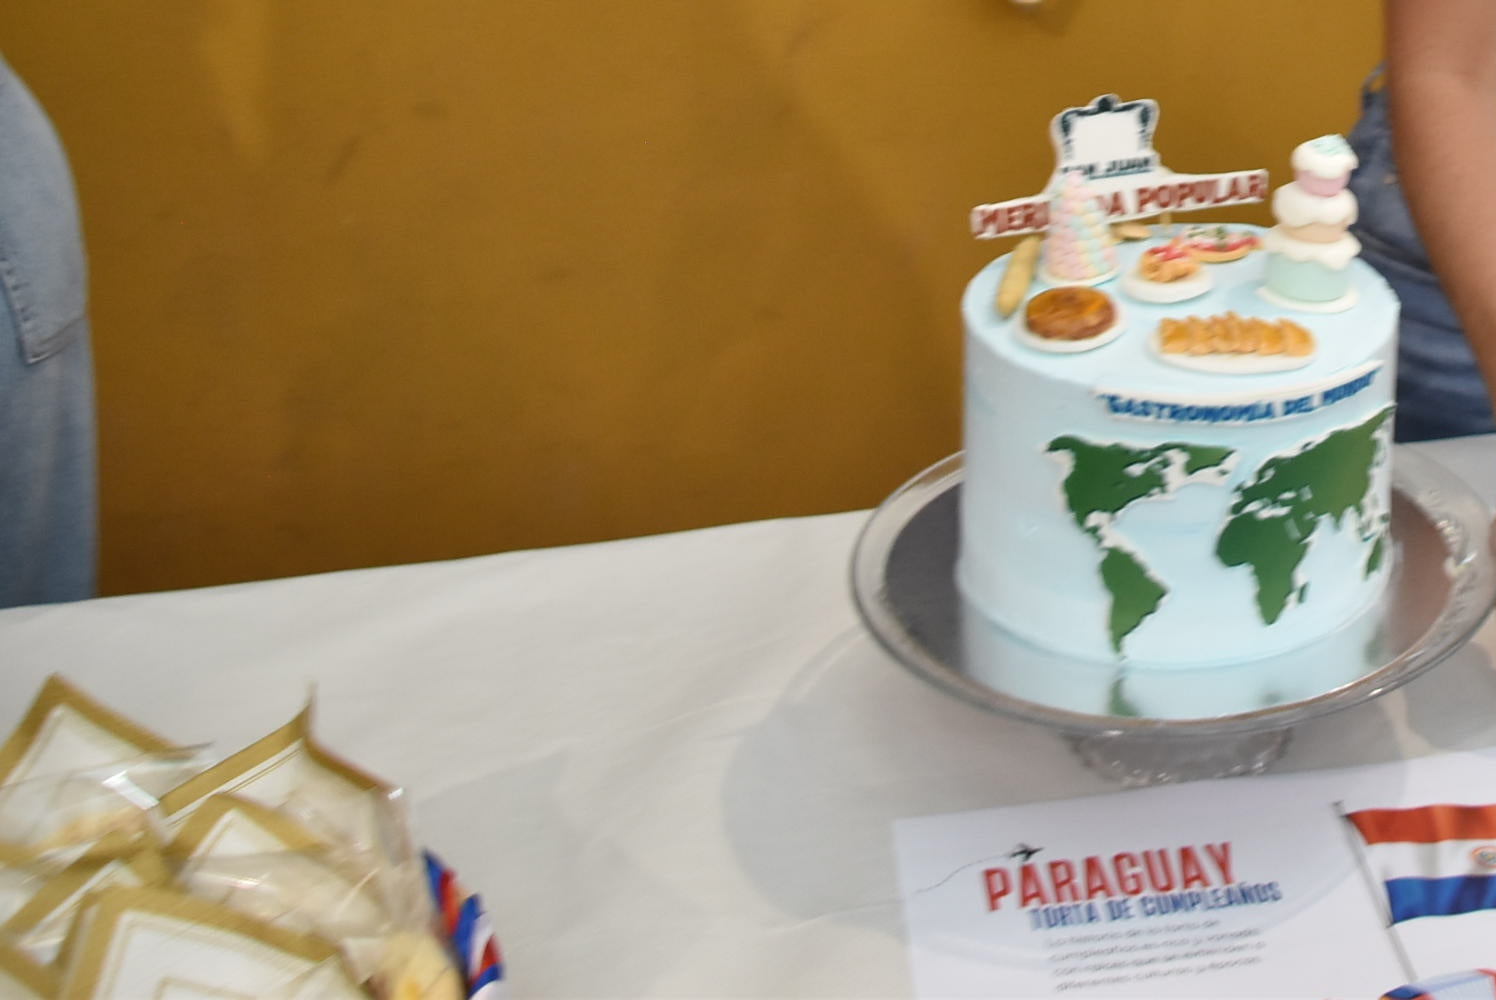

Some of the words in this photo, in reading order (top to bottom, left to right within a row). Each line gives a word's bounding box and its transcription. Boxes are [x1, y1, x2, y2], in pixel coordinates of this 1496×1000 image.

[1134, 173, 1267, 216] POPULAR
[1283, 394, 1315, 416] DEL
[981, 842, 1235, 912] PARAGUAY
[1027, 901, 1100, 931] TORTA
[1104, 897, 1136, 922] DE
[1140, 881, 1283, 918] CUMPLEAÑOS
